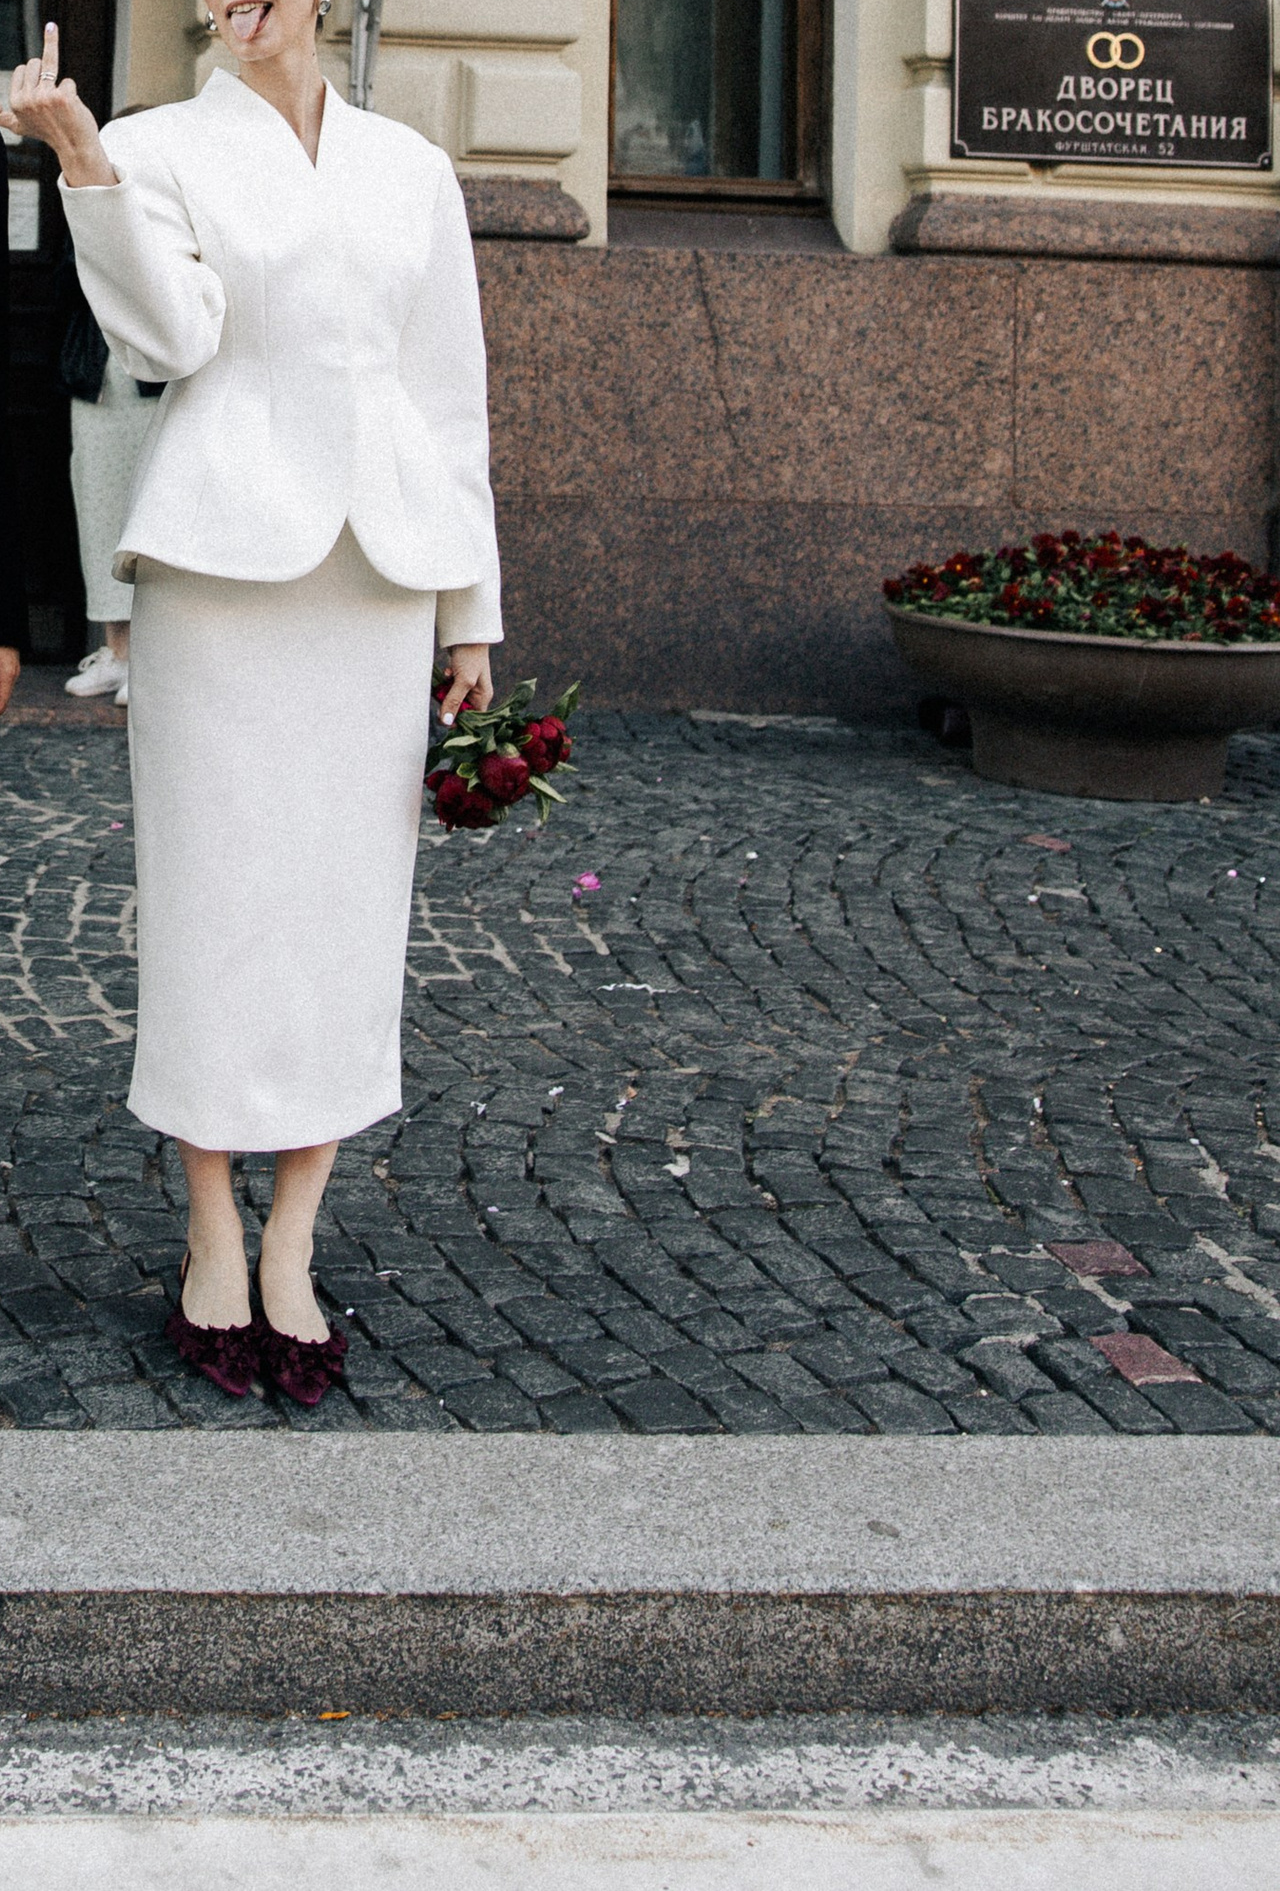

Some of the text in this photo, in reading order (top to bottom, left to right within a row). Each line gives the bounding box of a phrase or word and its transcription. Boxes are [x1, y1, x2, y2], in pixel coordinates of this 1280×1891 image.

[1057, 76, 1173, 104] ДВОРЕЦ
[982, 107, 1248, 140] БРАКОСОЧЕТАНИЯ
[1158, 143, 1174, 156] 52
